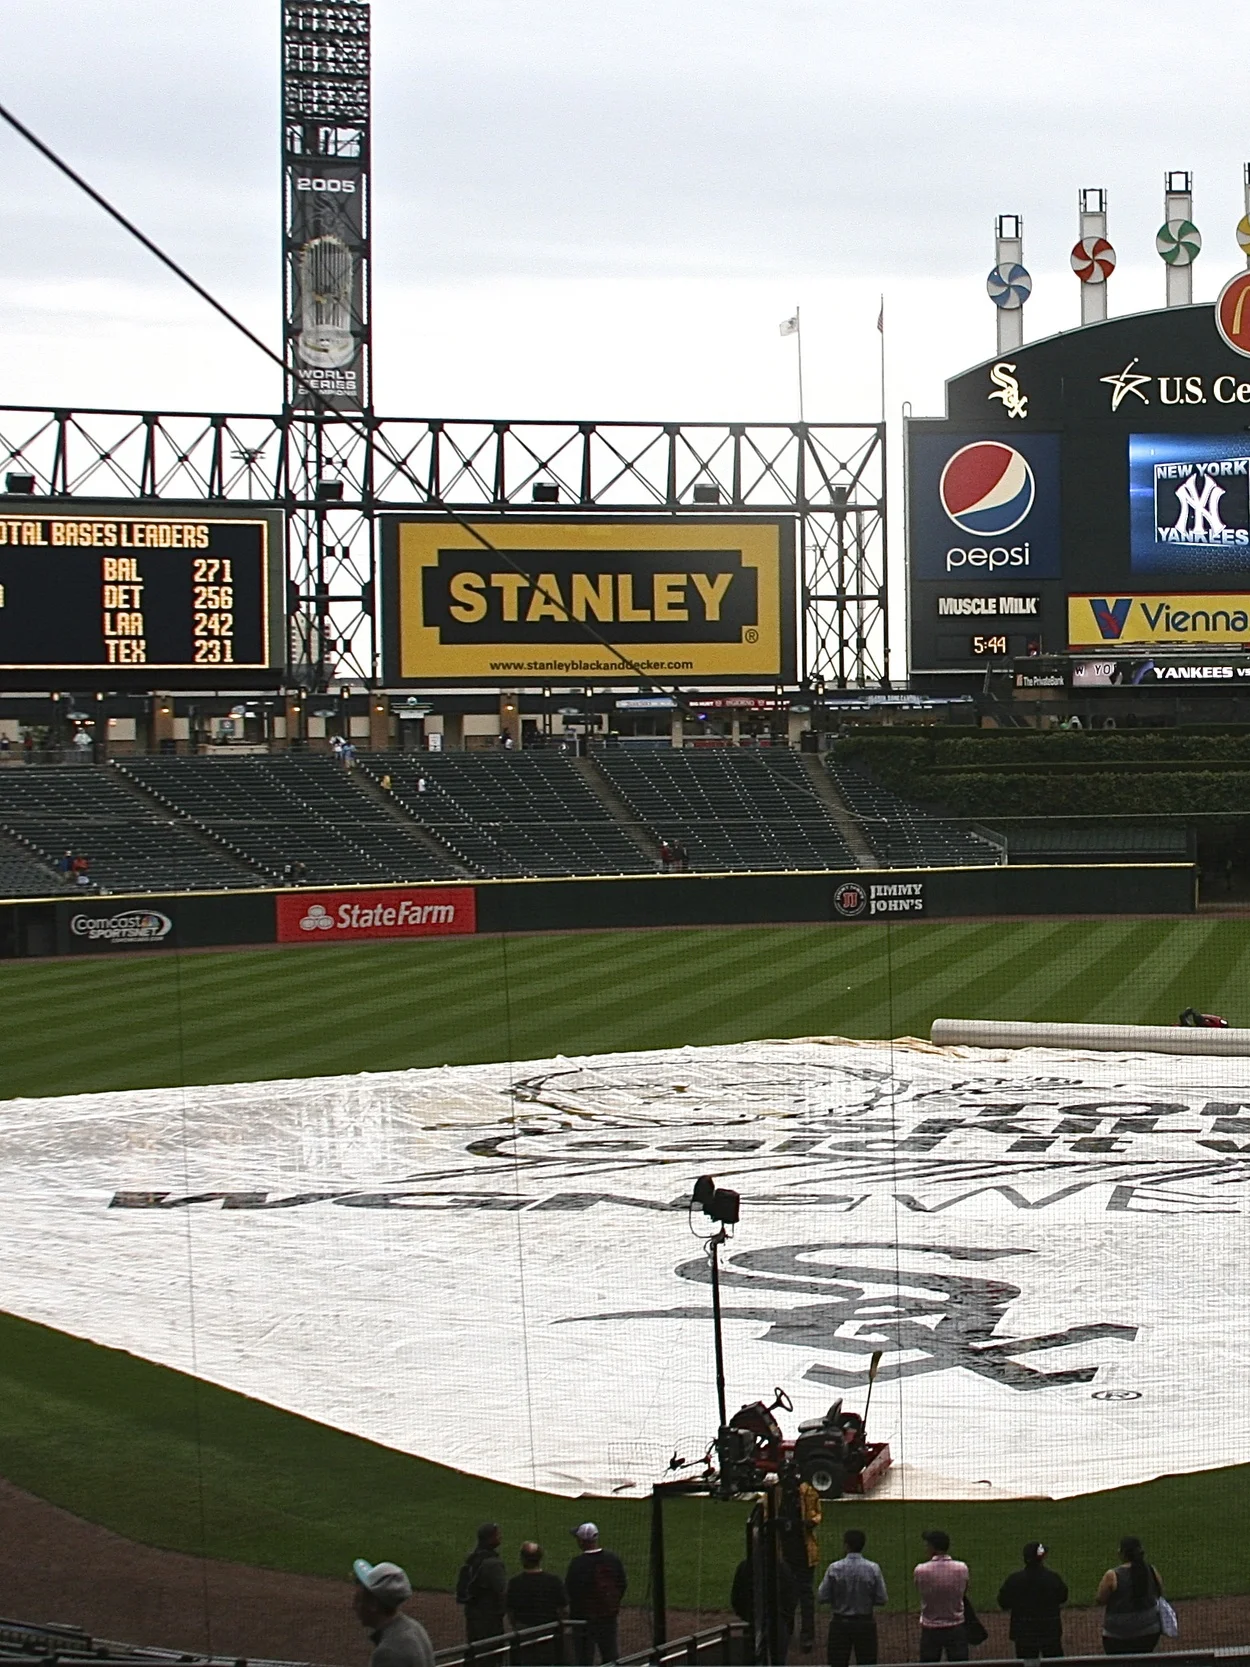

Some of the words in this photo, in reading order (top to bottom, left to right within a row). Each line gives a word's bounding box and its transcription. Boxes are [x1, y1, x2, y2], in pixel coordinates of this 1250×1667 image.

[297, 178, 356, 193] 2005
[298, 369, 357, 380] WORLD
[1158, 377, 1207, 405] U.S.
[1157, 463, 1193, 480] NEW
[1195, 460, 1248, 477] YORK
[52, 522, 118, 547] BASES
[121, 524, 209, 548] LEADERS
[1158, 526, 1249, 546] YANKEES
[946, 542, 1030, 572] pepsi
[103, 557, 144, 583] BAL
[192, 558, 234, 583] 271
[103, 585, 144, 610] DET
[192, 586, 234, 610] 256
[449, 571, 733, 623] STANLEY
[938, 597, 997, 615] MUSCLE
[999, 597, 1037, 615] MILK
[103, 612, 144, 637] LAA
[193, 613, 234, 637] 242
[1140, 602, 1249, 632] Vienna
[104, 639, 147, 664] TEX
[193, 640, 234, 664] 231
[973, 636, 1007, 654] 5:44
[489, 659, 694, 672] www.stanleyblackanddecker.com
[1153, 666, 1234, 679] YANKEES
[1024, 676, 1033, 686] The
[869, 883, 923, 899] JIMMY
[869, 899, 923, 914] JOHN'S
[88, 927, 160, 939] SPORTSNET
